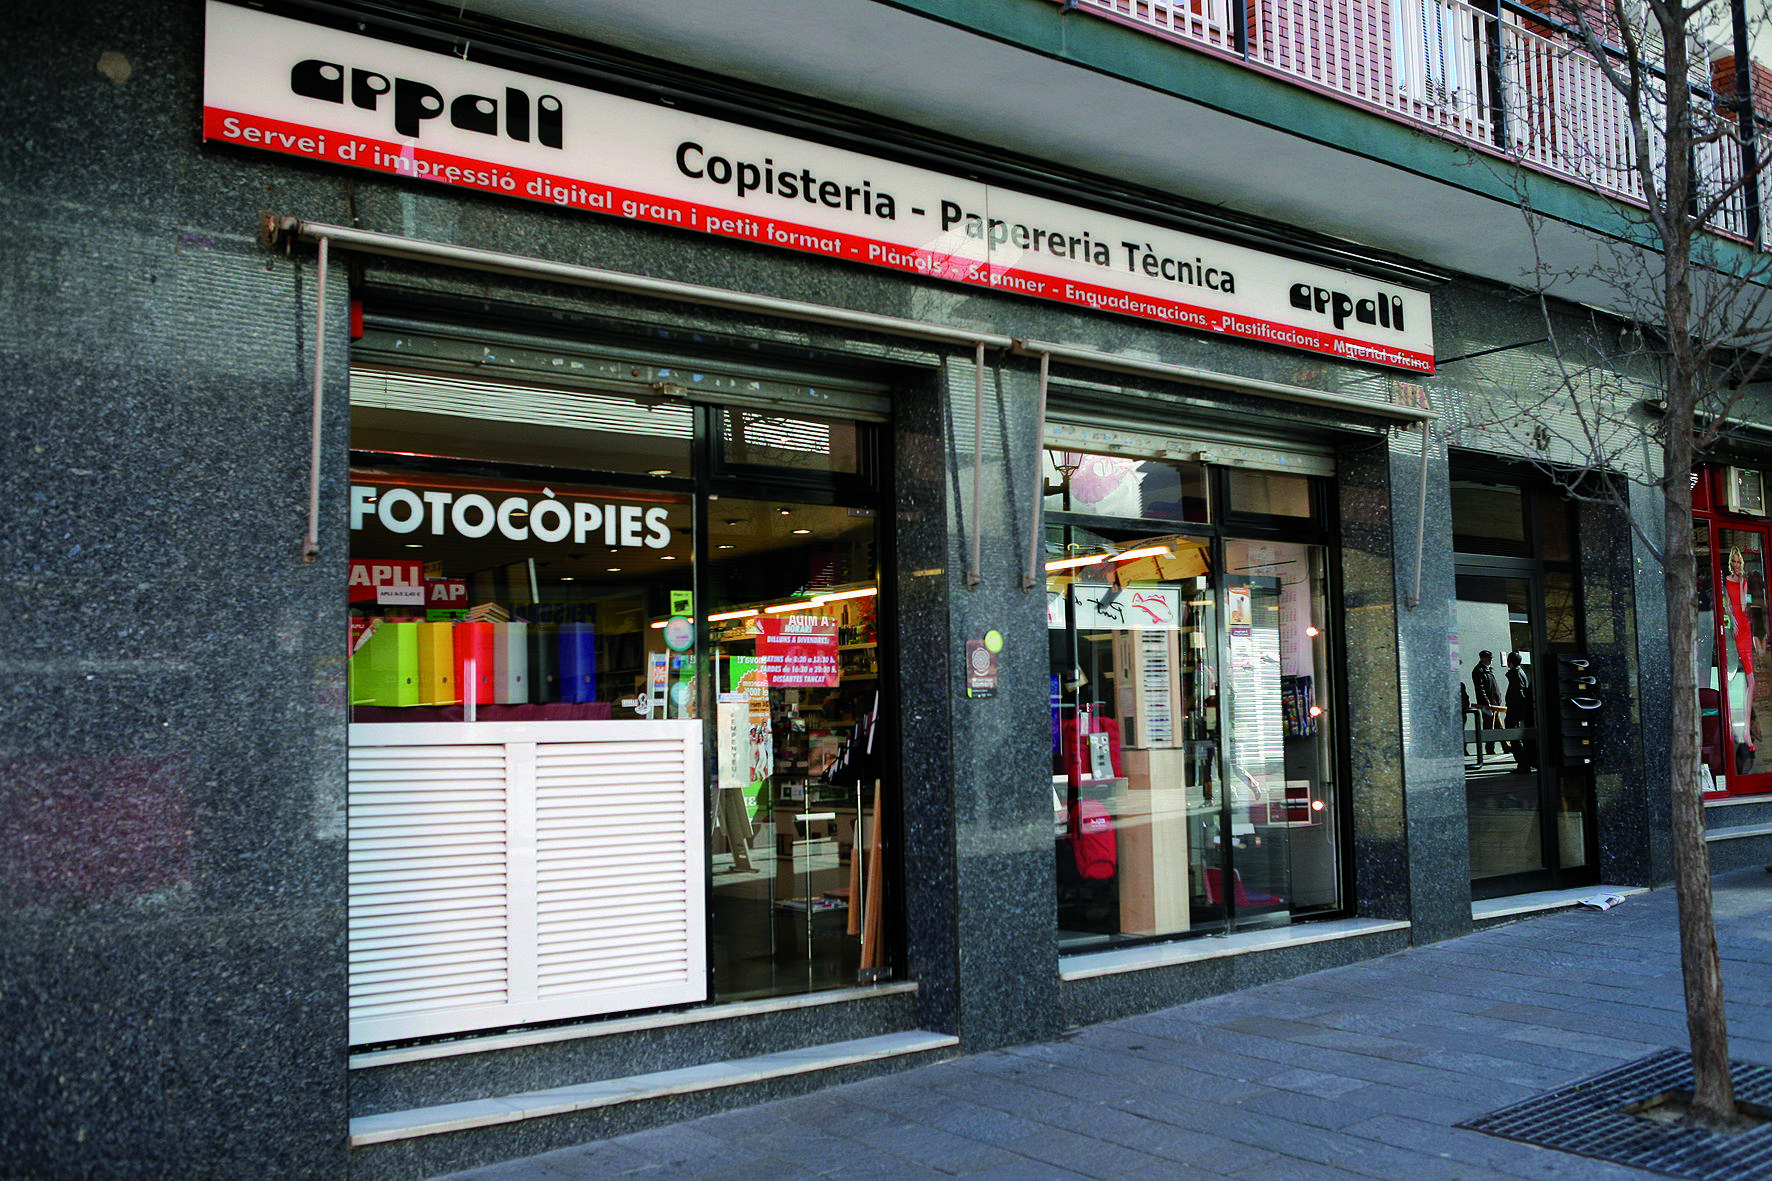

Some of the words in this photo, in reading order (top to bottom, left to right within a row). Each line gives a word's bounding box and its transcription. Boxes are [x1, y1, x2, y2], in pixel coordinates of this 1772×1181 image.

[222, 117, 325, 155] Servei
[374, 145, 516, 190] impressió
[526, 177, 612, 208] digital
[621, 200, 682, 223] gran
[691, 208, 698, 225] i
[706, 216, 760, 238] petit
[766, 223, 842, 254] format
[868, 243, 942, 275] Plànols
[969, 264, 1046, 293] Scanner
[1065, 283, 1207, 326] Enquadernacions
[1222, 316, 1320, 348] Plastificacions
[1333, 339, 1388, 362] Material
[1390, 351, 1430, 371] oficina
[675, 141, 896, 221] Copisteria
[940, 199, 1111, 268] Papereria
[1121, 241, 1235, 294] Tècnica
[350, 486, 672, 550] FOTOCÒPIES
[349, 564, 419, 587] APLI
[766, 635, 791, 643] DILLUNS
